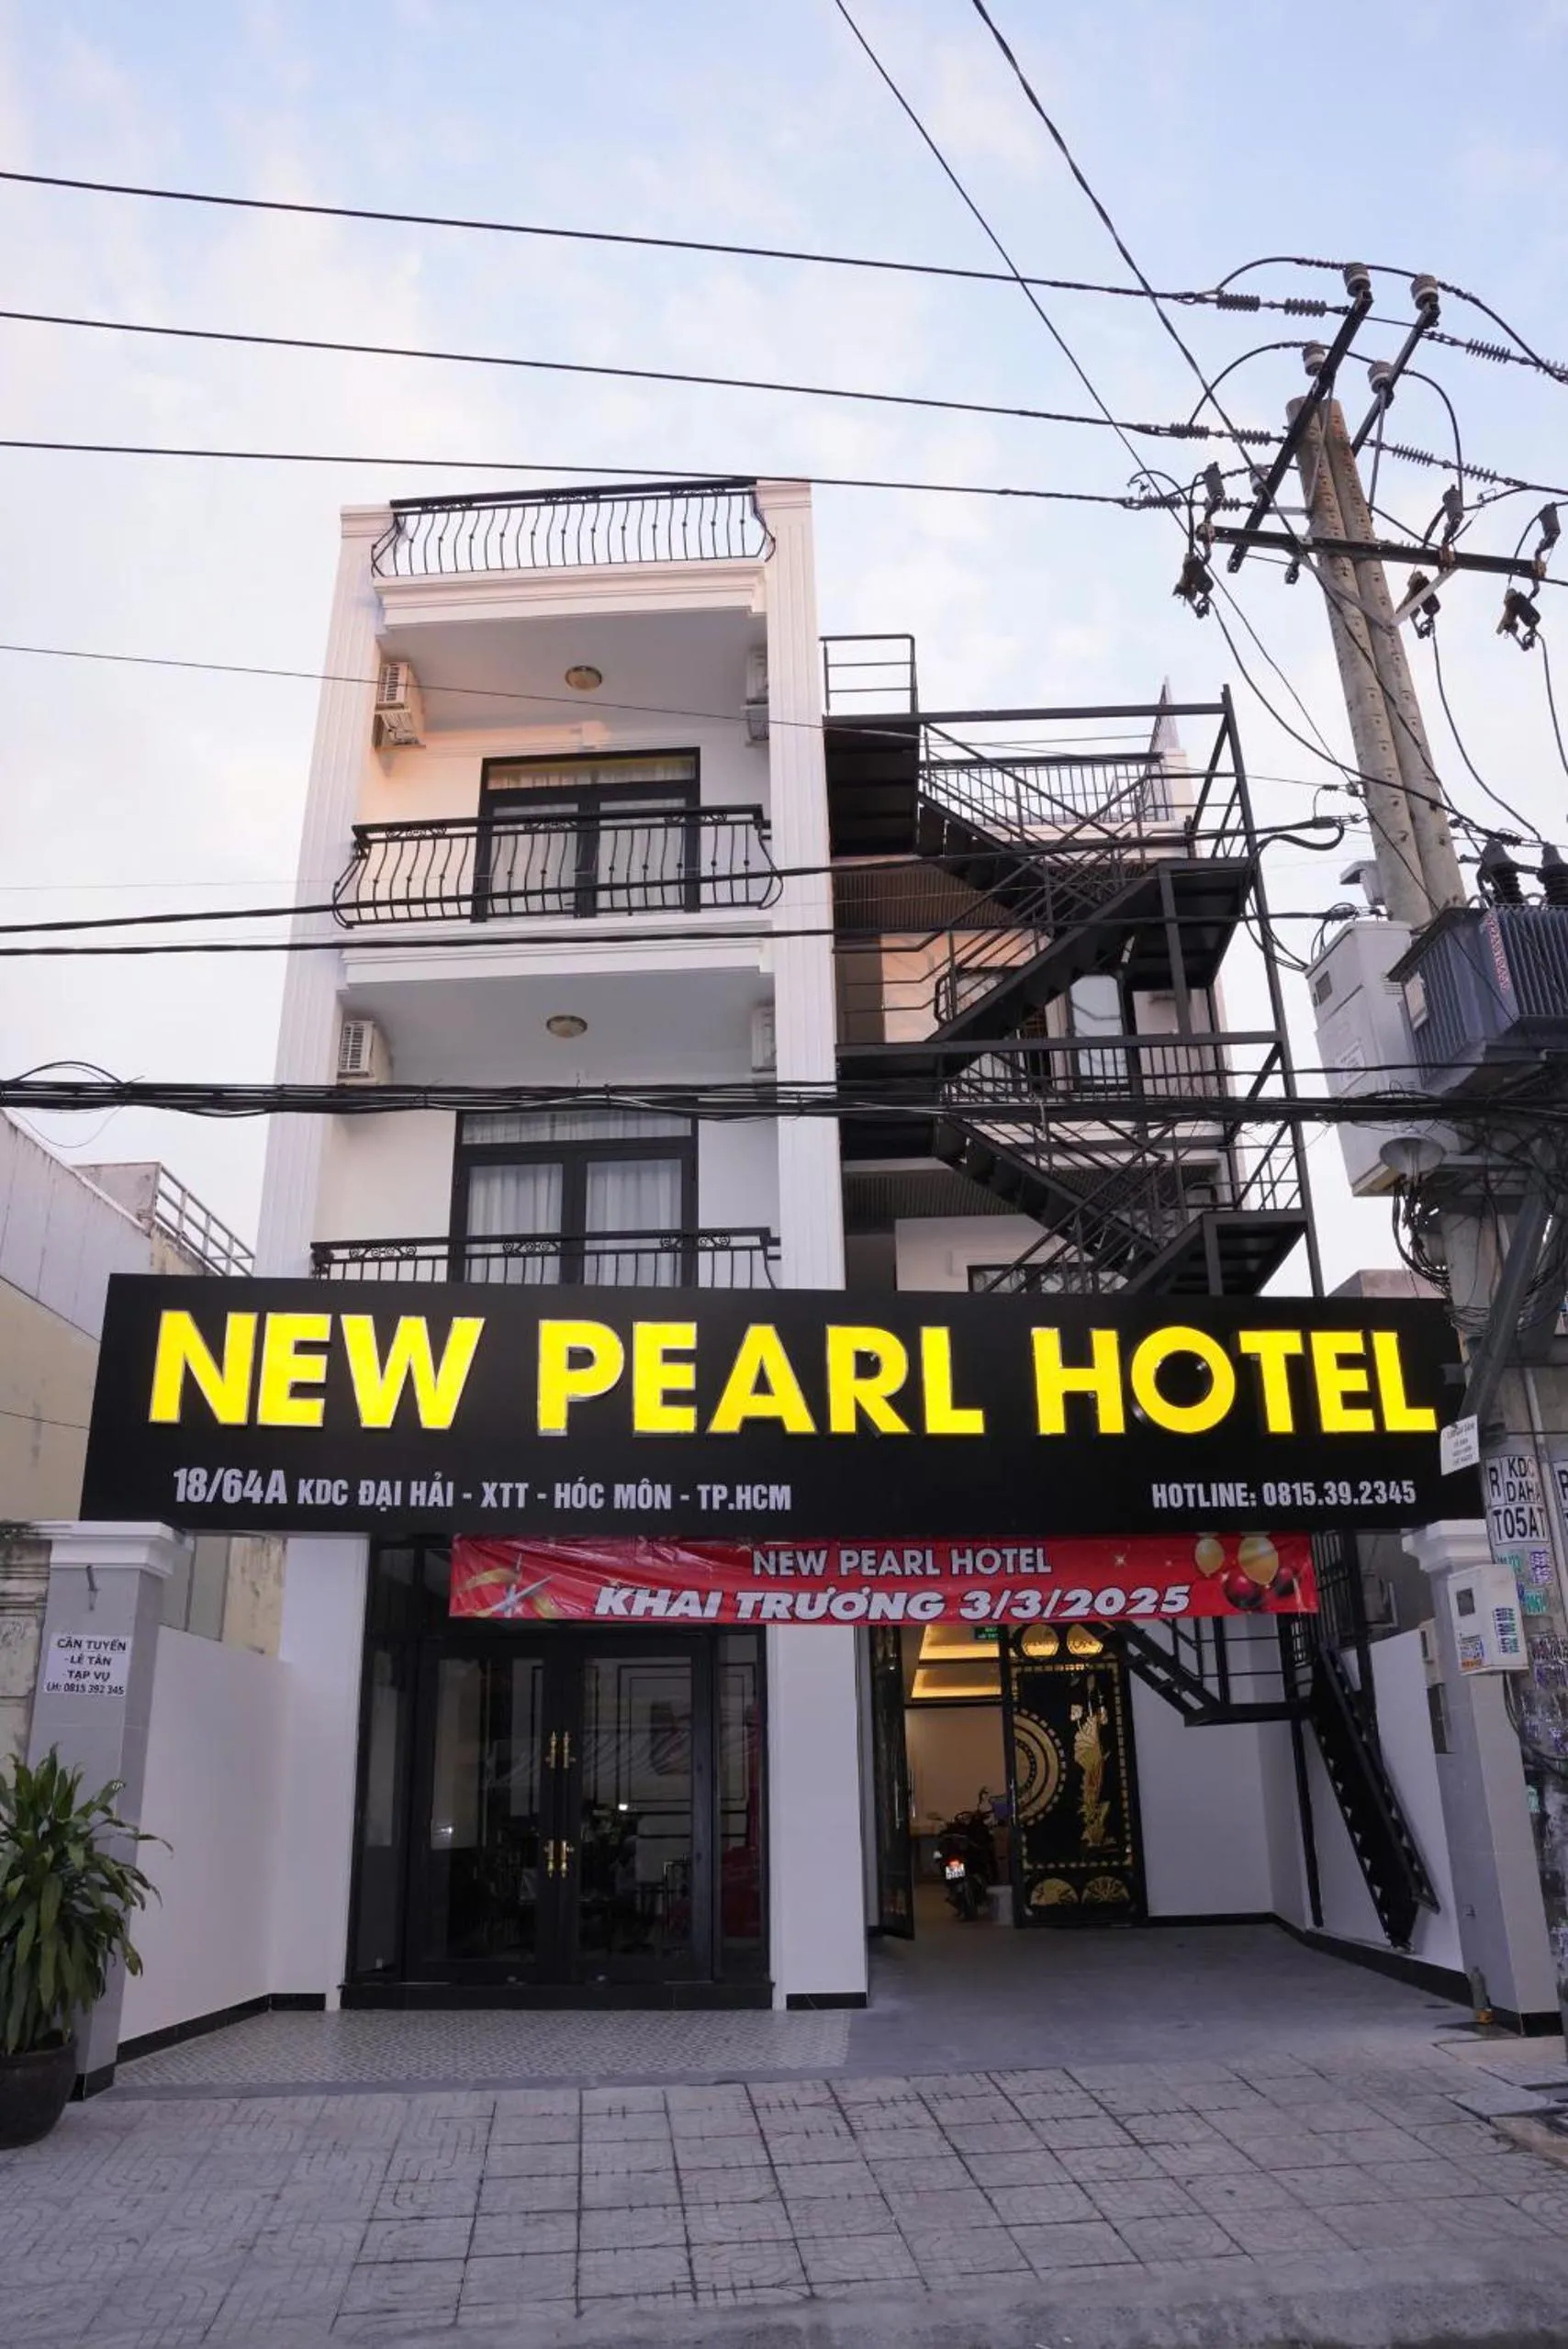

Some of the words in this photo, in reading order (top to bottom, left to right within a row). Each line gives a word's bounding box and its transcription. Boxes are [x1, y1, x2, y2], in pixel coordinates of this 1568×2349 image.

[148, 1310, 486, 1429] NEW
[536, 1318, 986, 1436] PEARL
[1030, 1326, 1439, 1436] HOTEL
[173, 1467, 288, 1504] 18/64A
[297, 1478, 349, 1506] KDC
[358, 1479, 402, 1512] ĐẠI
[409, 1471, 454, 1507] HẢI
[480, 1482, 530, 1509] XTT
[554, 1476, 605, 1510] HÓC
[613, 1477, 672, 1510] MÔN
[697, 1483, 791, 1511] TP.HCM
[1151, 1482, 1257, 1508] HOTLINE:
[1262, 1480, 1417, 1506] 0815.39.2345
[752, 1549, 828, 1576] NEW
[839, 1549, 940, 1576] PEARL
[950, 1547, 1052, 1574] HOTEL
[593, 1585, 723, 1619] KHAI
[734, 1585, 946, 1621] TRƯƠNG
[958, 1584, 1191, 1620] 3/3/2025
[63, 1683, 86, 1693] 0815
[107, 1685, 125, 1695] 345
[94, 1671, 111, 1683] VỤ
